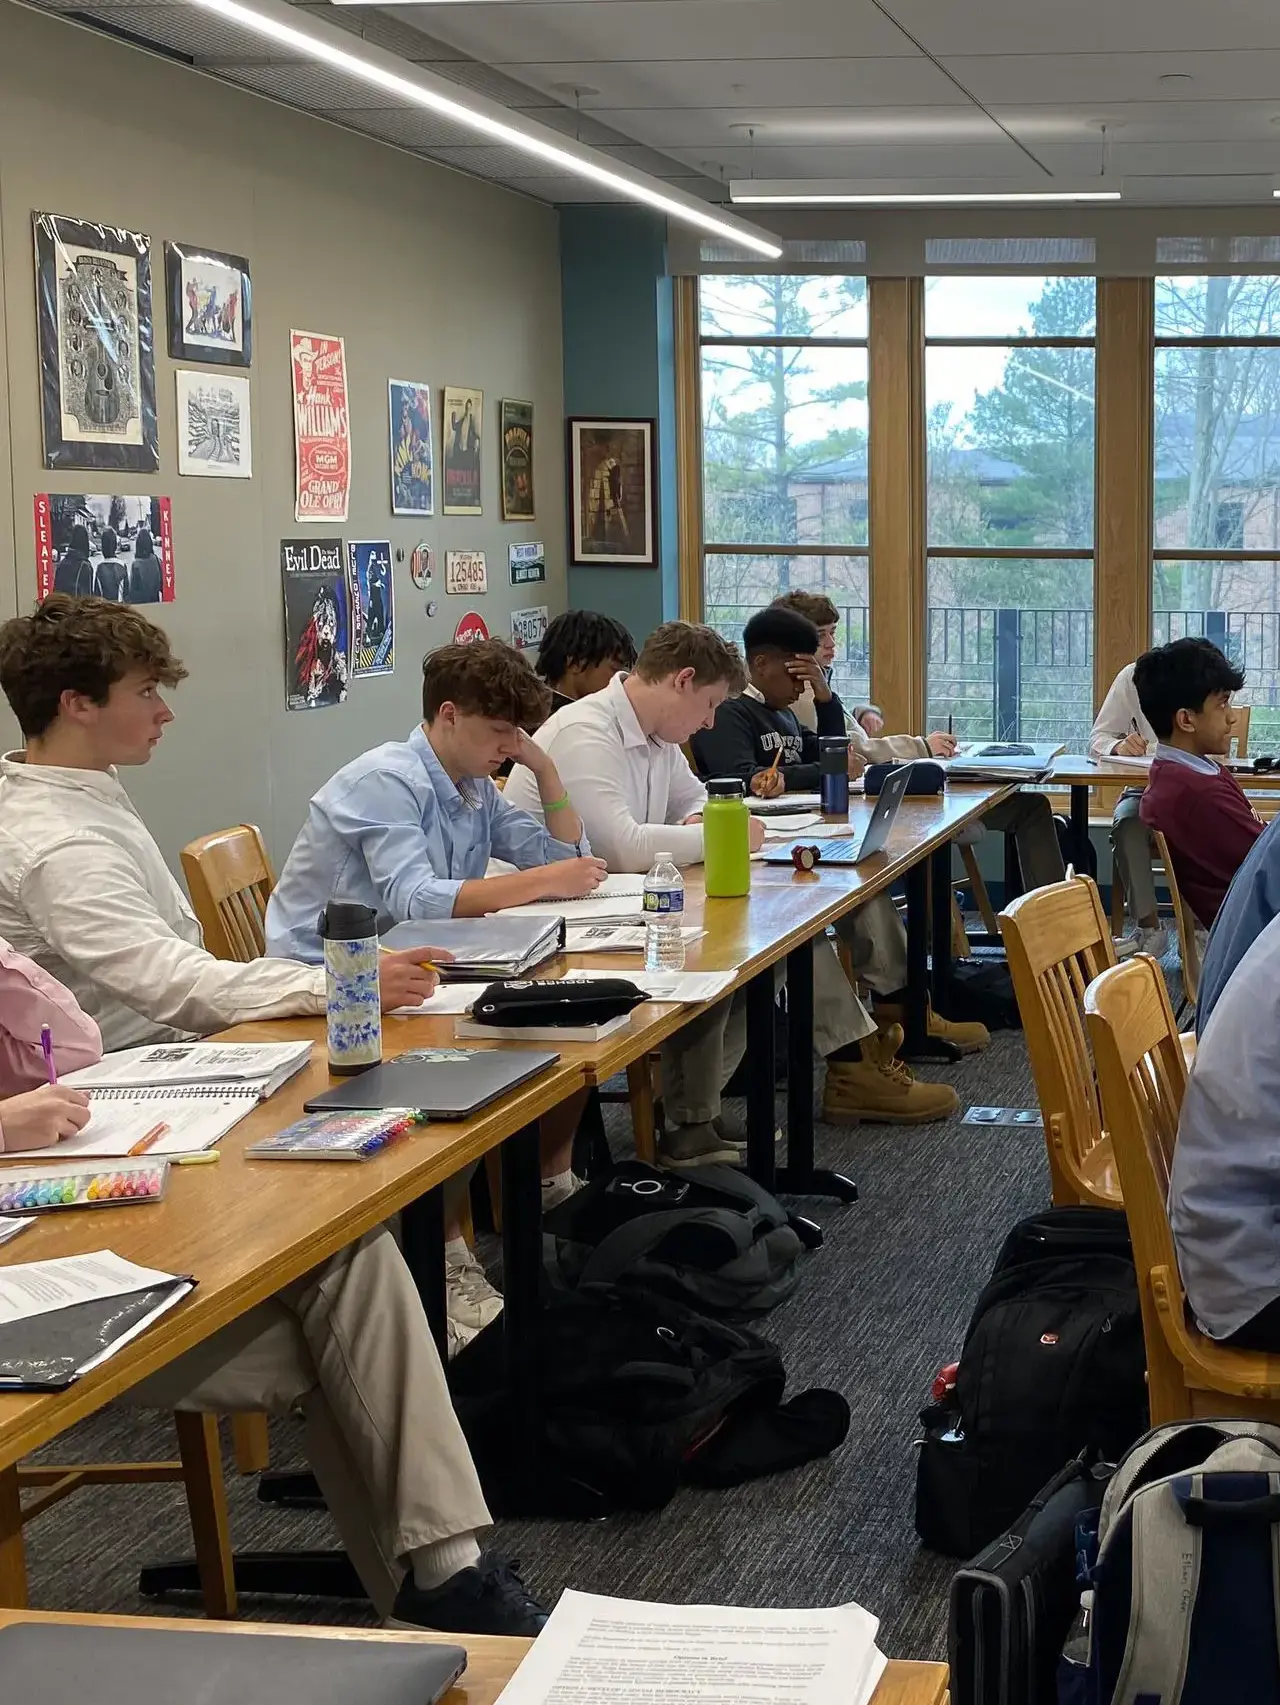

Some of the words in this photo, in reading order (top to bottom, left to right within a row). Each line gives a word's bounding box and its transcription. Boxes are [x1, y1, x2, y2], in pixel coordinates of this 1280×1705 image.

[306, 384, 332, 407] Hank
[298, 402, 348, 438] WILLIAMS
[315, 454, 338, 465] MGM
[308, 479, 340, 495] GRAND
[300, 490, 321, 508] OLE
[163, 510, 172, 588] KINNEY
[285, 546, 308, 572] Evil
[310, 545, 341, 572] Dead
[450, 561, 484, 582] 125485
